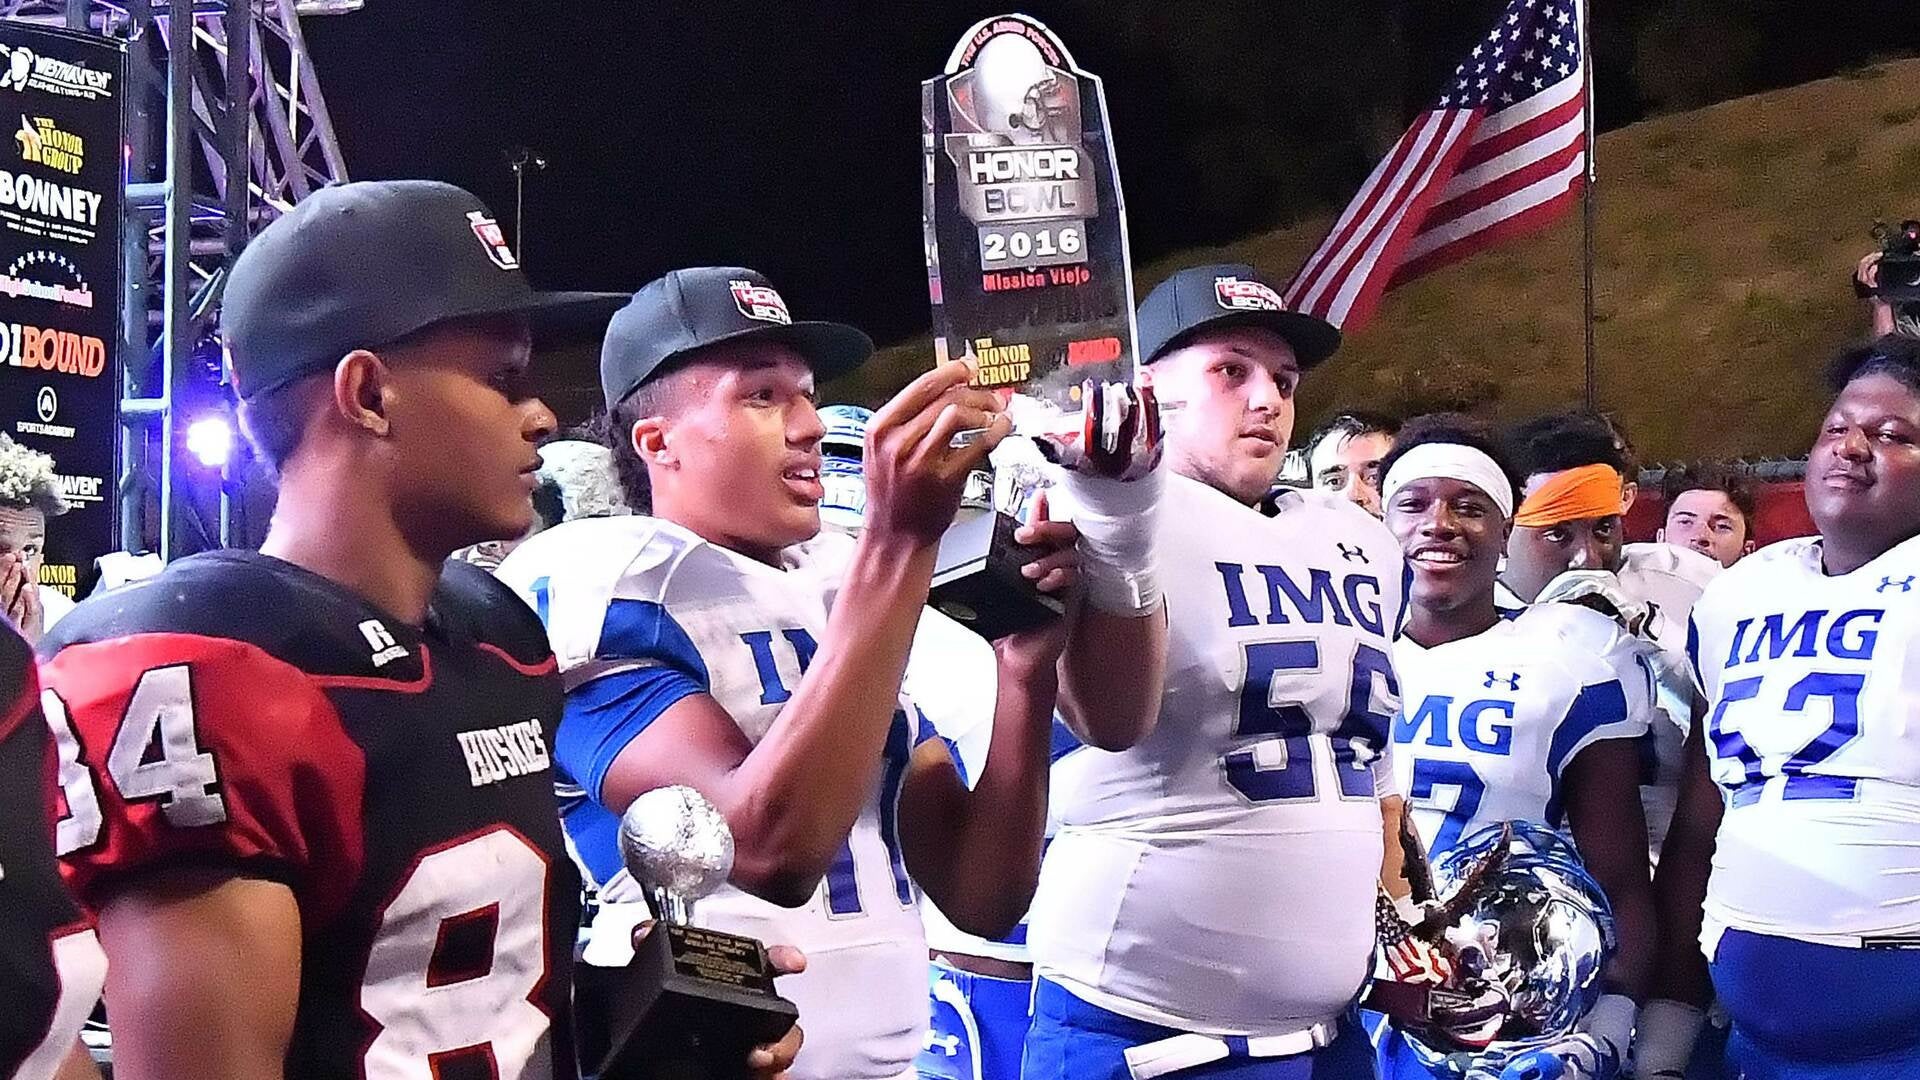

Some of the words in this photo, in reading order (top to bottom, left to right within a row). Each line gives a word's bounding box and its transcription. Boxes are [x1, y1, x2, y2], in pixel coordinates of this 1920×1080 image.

[33, 117, 56, 129] THE
[38, 127, 84, 157] HONOR
[42, 146, 84, 175] GROUP
[968, 149, 1081, 184] HONOR
[0, 170, 102, 226] BONNEY
[984, 185, 1077, 213] BOWL
[983, 227, 1081, 262] 2016
[981, 270, 1047, 292] Mission
[977, 343, 1031, 368] HONOR
[978, 363, 1031, 387] GROUP
[1214, 561, 1386, 637] IMG
[1724, 608, 1886, 669] IMG
[1222, 638, 1402, 802] 56
[1393, 694, 1516, 756] MG
[456, 718, 551, 787] HUSKIES
[1708, 671, 1867, 809] 52
[1408, 757, 1487, 862] 7
